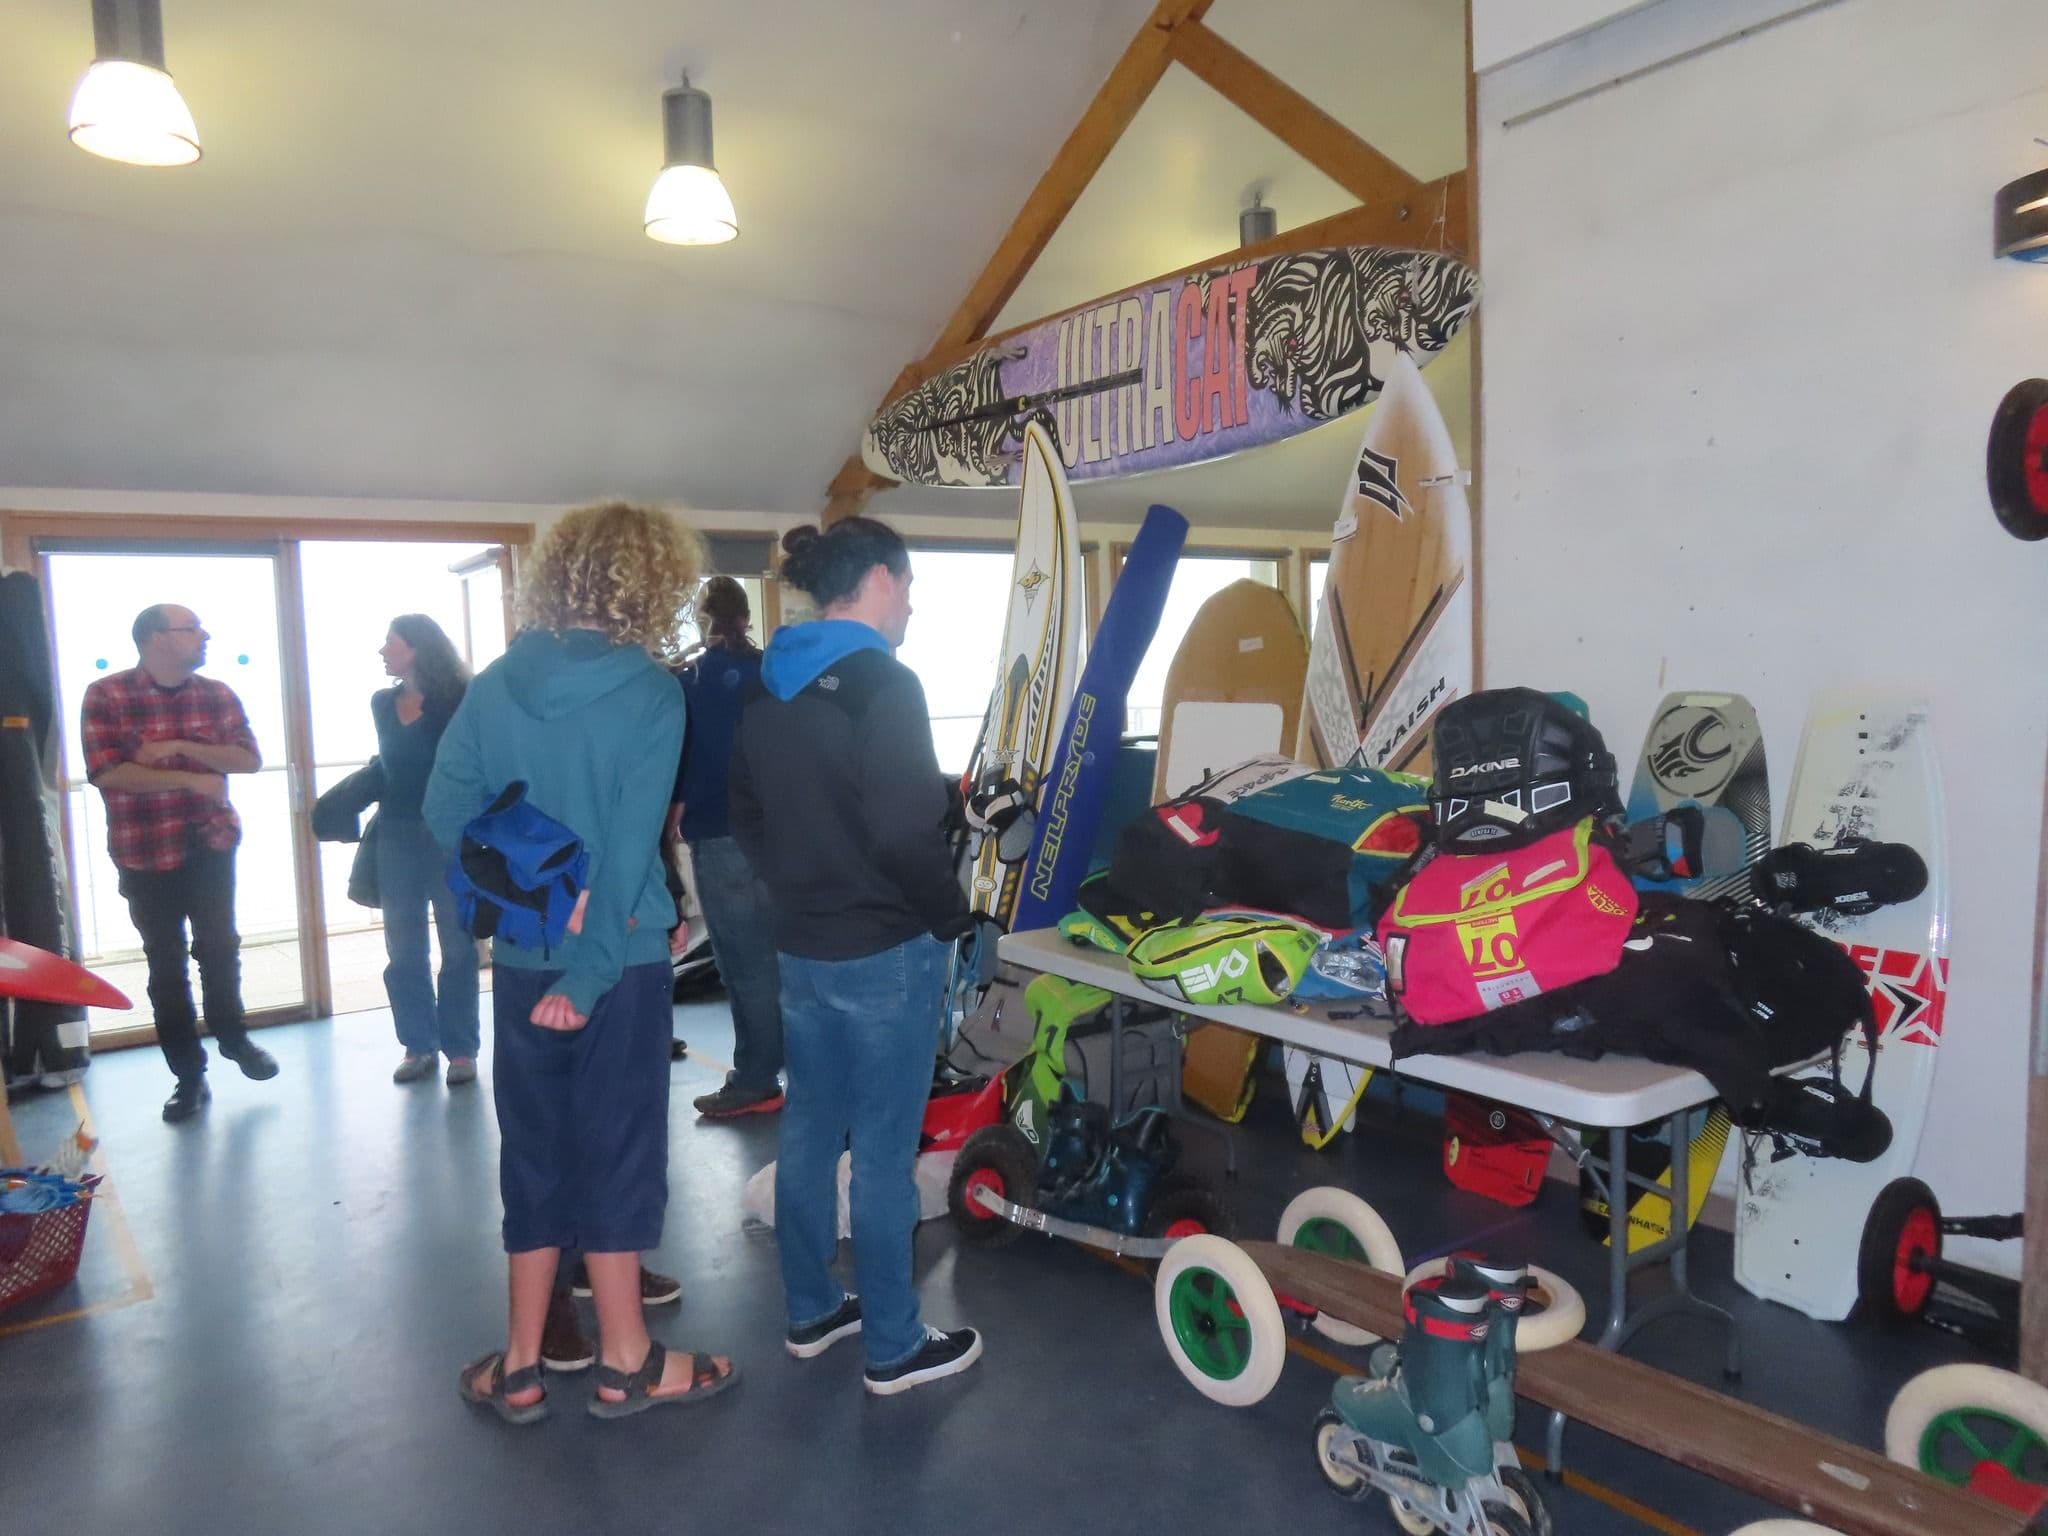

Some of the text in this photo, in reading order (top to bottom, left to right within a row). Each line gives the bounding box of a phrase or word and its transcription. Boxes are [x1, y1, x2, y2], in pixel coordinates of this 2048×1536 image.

[1377, 677, 1446, 765] NAISH
[1031, 693, 1097, 900] NEILPRYDE
[1450, 757, 1522, 779] DAKINE
[1181, 948, 1249, 994] EVO
